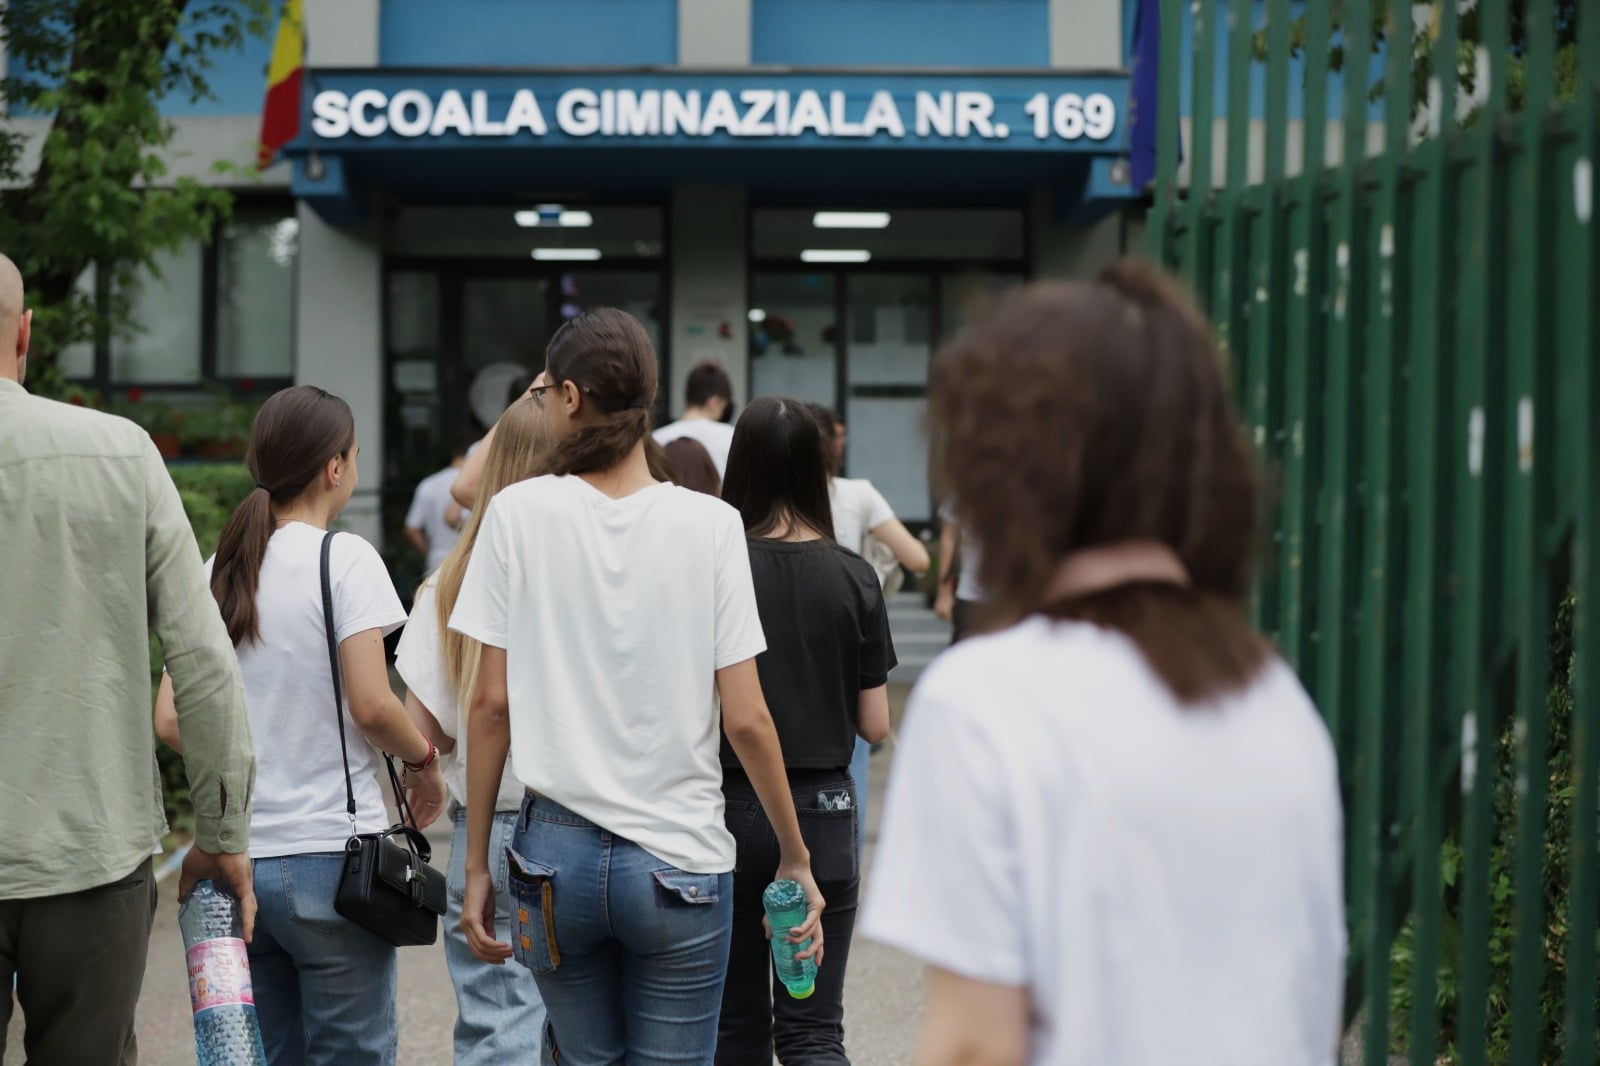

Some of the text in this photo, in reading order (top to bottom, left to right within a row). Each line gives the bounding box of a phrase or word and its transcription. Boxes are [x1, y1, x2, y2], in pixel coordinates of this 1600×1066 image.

[312, 88, 1115, 139] SCOALA GIMNAZIALA NR. 169
